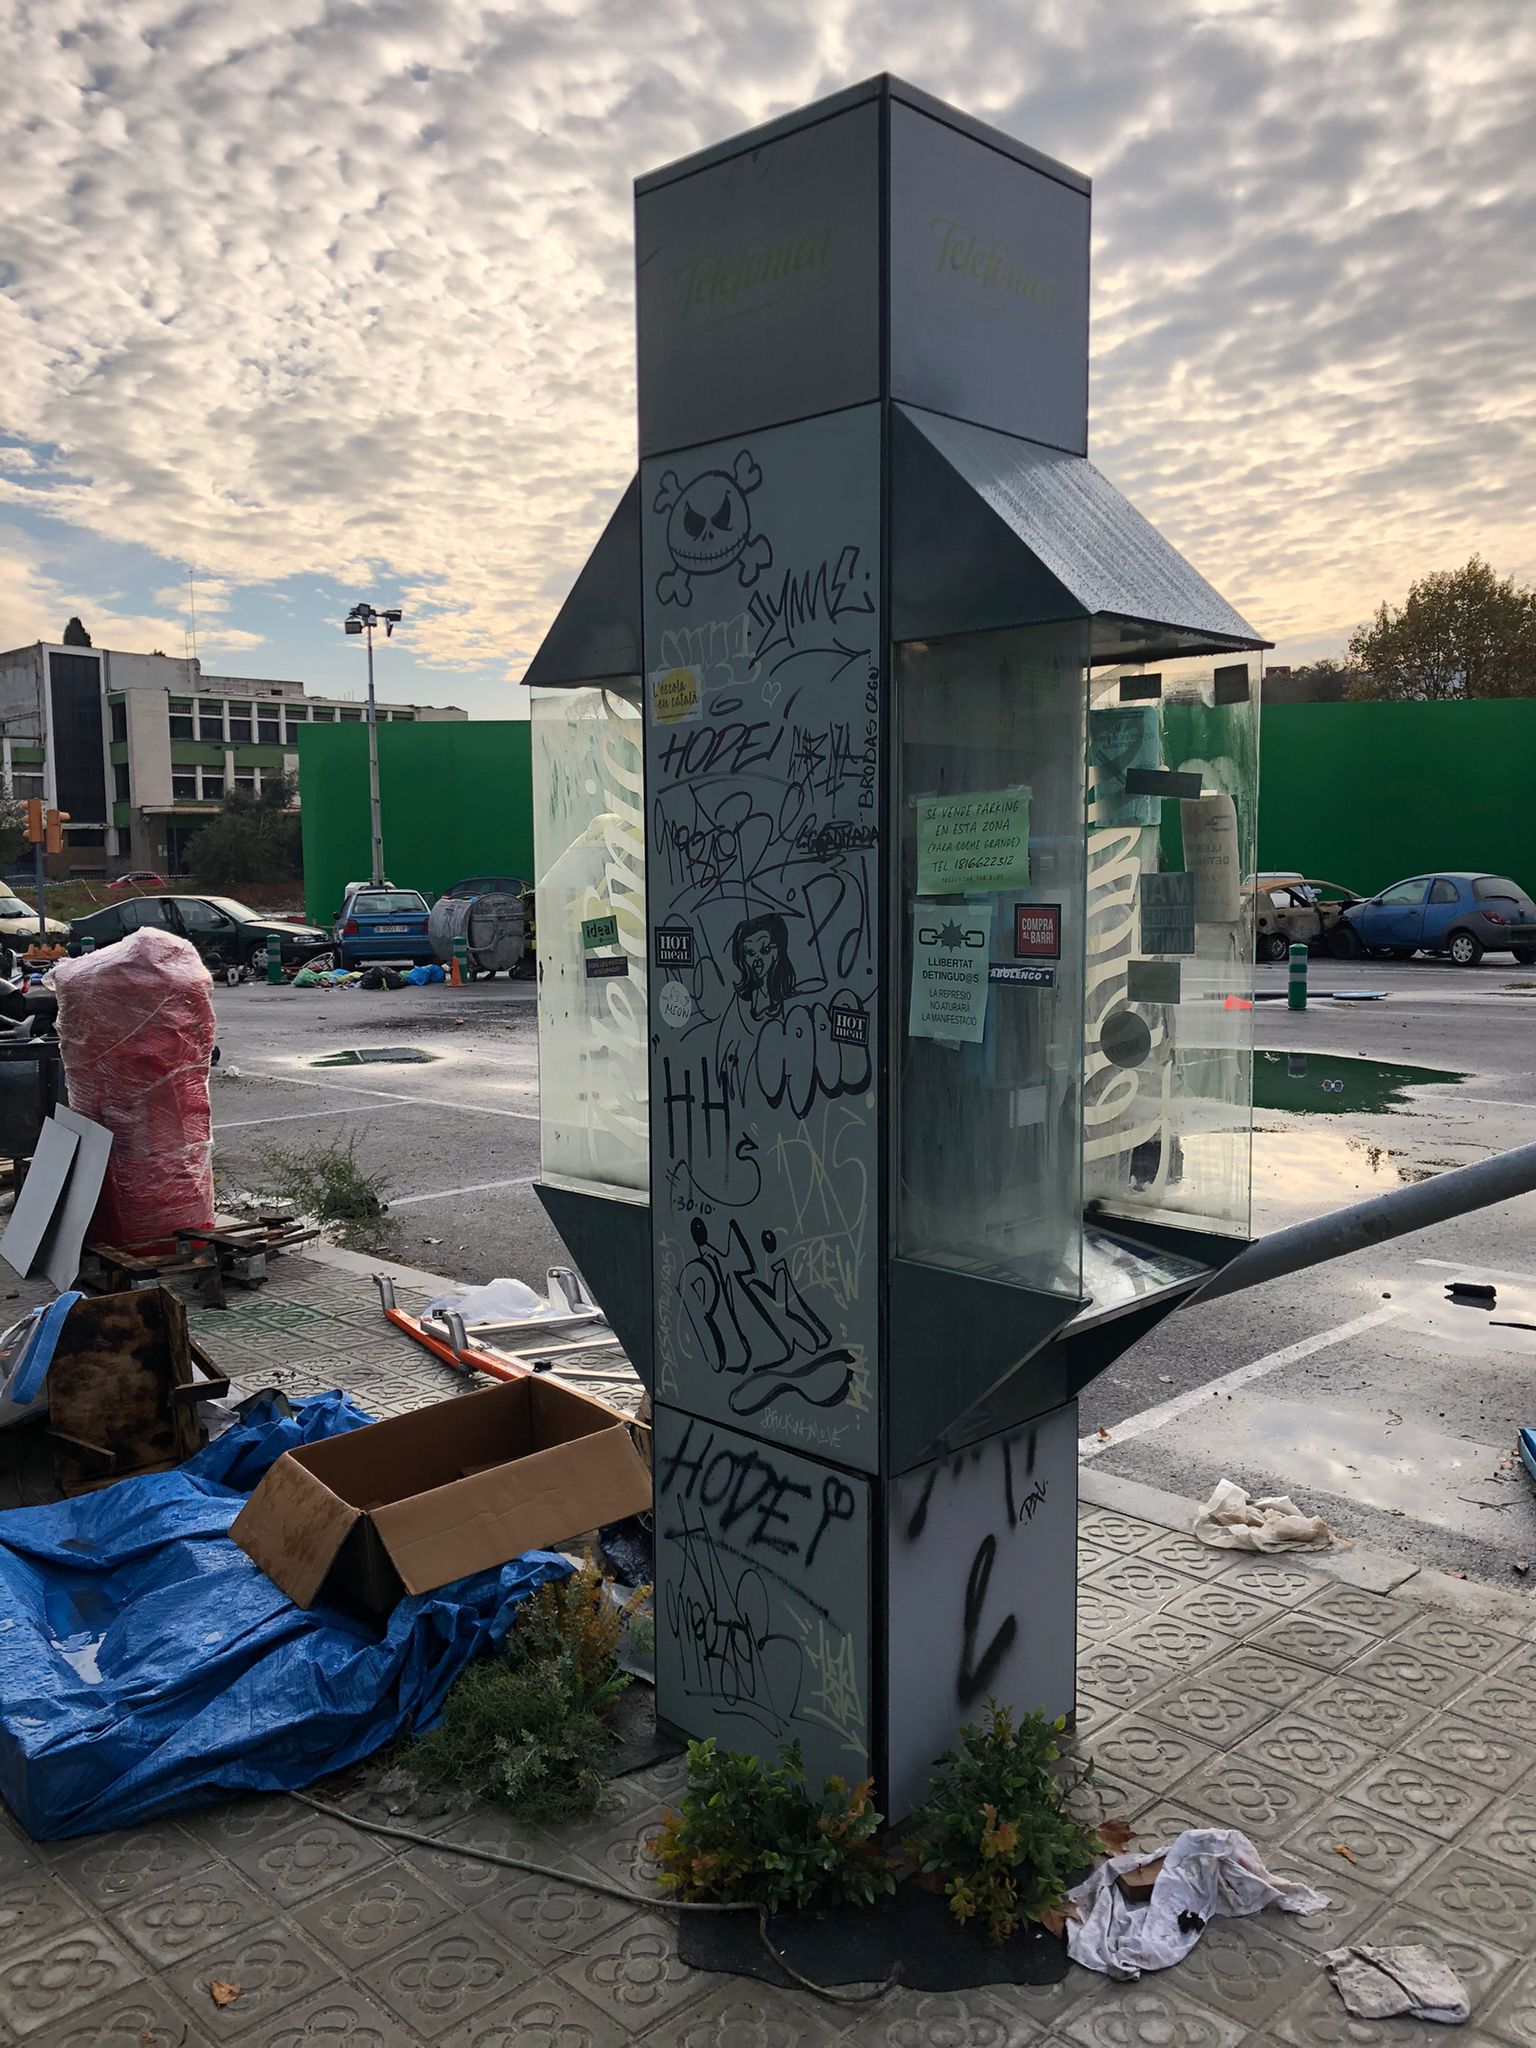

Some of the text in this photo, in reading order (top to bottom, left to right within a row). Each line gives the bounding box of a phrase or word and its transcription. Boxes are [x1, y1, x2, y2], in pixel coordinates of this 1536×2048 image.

[657, 698, 670, 710] en
[926, 800, 1019, 820] SE VENDE PARKING
[935, 819, 1010, 837] EN ESTA ZONA
[956, 840, 981, 851] COCHE
[984, 836, 1021, 850] GRANDE)
[932, 860, 949, 873] TEL
[587, 920, 614, 938] ideal
[1021, 918, 1054, 931] COMPRA
[660, 935, 690, 950] HOT
[1022, 931, 1054, 945] AL BARRI
[928, 957, 974, 969] LLIBERTAT
[922, 970, 979, 984] DETINGUD@S
[989, 969, 1042, 981] ABOLENGO
[929, 988, 938, 998] LA
[836, 1014, 866, 1031] HOT
[921, 1012, 931, 1022] LA
